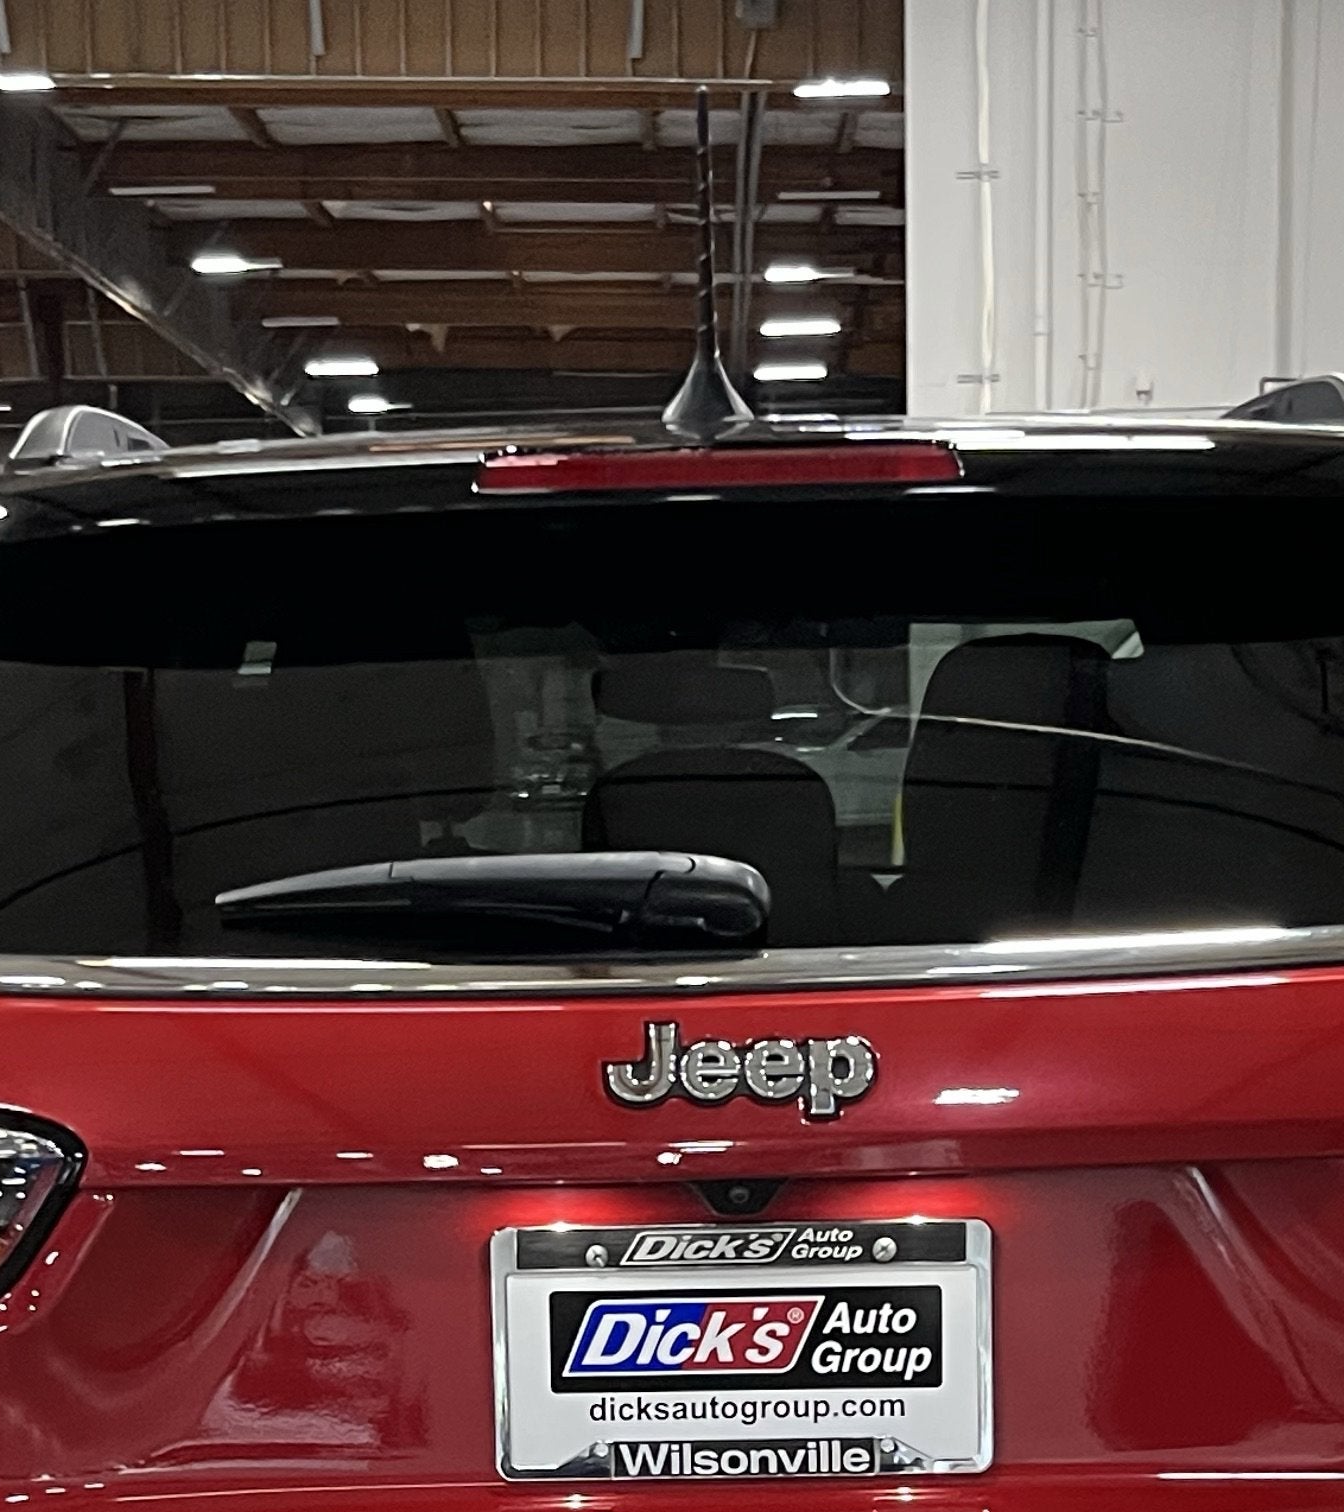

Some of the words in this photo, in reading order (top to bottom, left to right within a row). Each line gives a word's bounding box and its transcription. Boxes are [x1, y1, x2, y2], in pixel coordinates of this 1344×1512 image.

[603, 1020, 878, 1118] Jeep
[632, 1232, 777, 1261] Dick's
[798, 1228, 854, 1243] Auto
[791, 1243, 863, 1263] Group
[822, 1301, 917, 1334] Auto
[581, 1307, 793, 1366] Dick's
[811, 1340, 932, 1381] Group
[589, 1396, 907, 1425] dicksautogroup.com
[619, 1440, 871, 1476] Wilsonville
